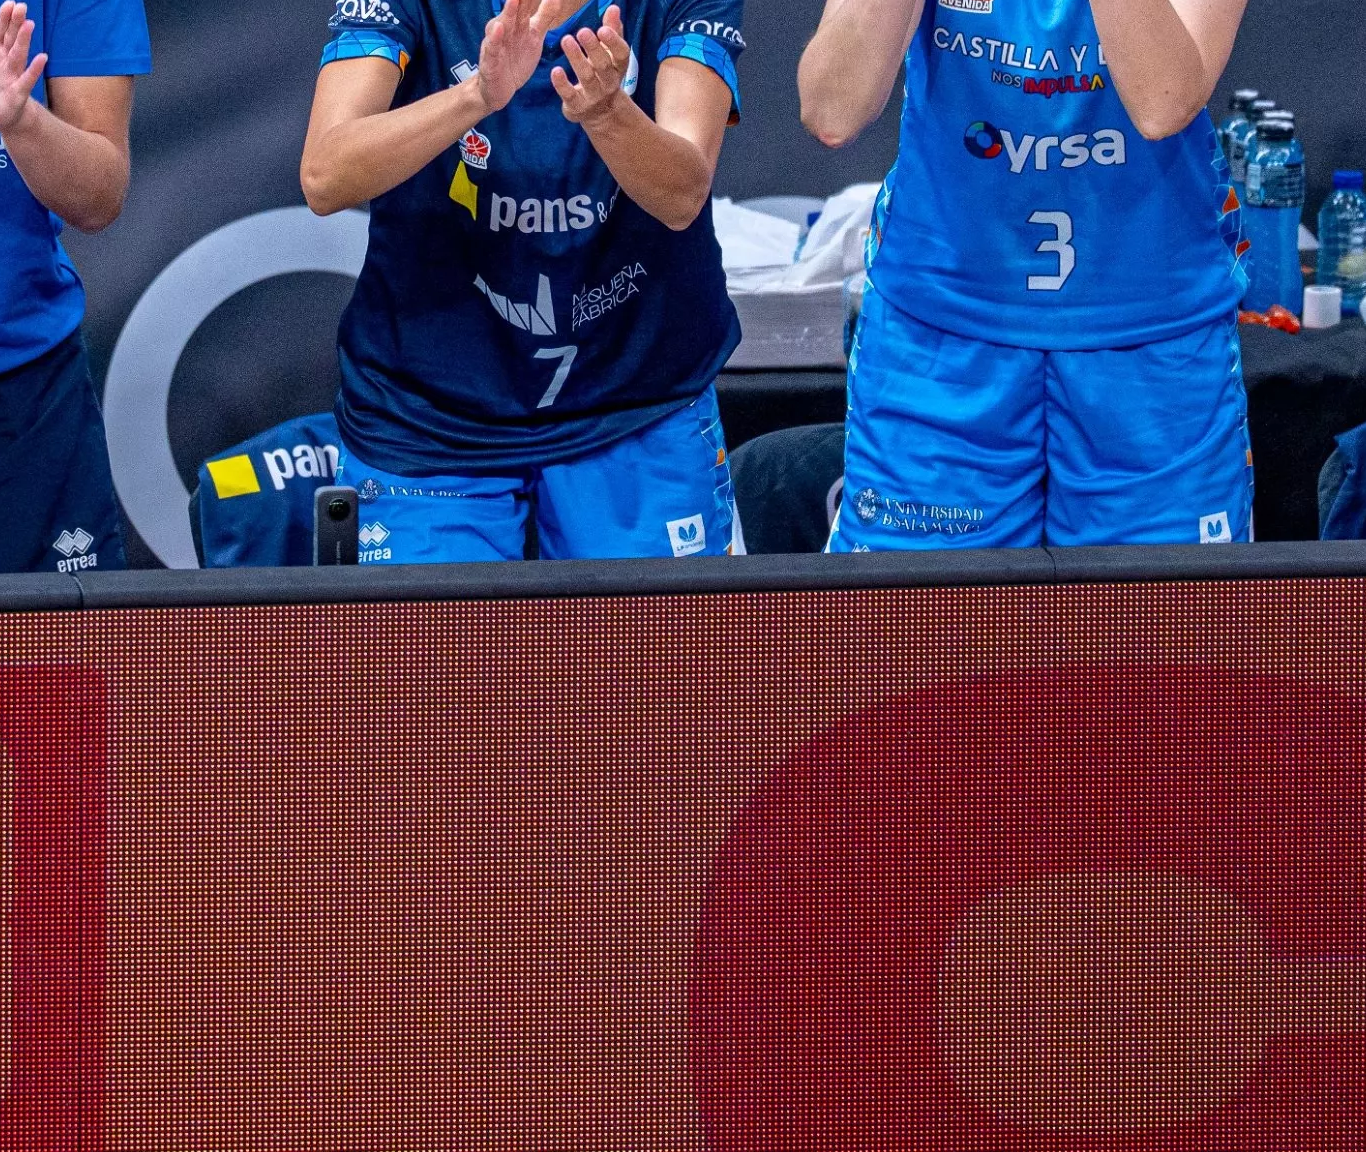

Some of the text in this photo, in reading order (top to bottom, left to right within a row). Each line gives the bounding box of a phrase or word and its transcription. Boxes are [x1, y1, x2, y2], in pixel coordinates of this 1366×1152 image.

[934, 28, 1059, 71] CASTILLA
[1070, 46, 1087, 73] Y
[992, 69, 1022, 88] NOS
[490, 192, 595, 234] pans
[597, 201, 608, 223] &
[1027, 211, 1076, 290] 3
[533, 345, 578, 409] 7
[263, 444, 340, 490] pan
[56, 552, 98, 574] errea
